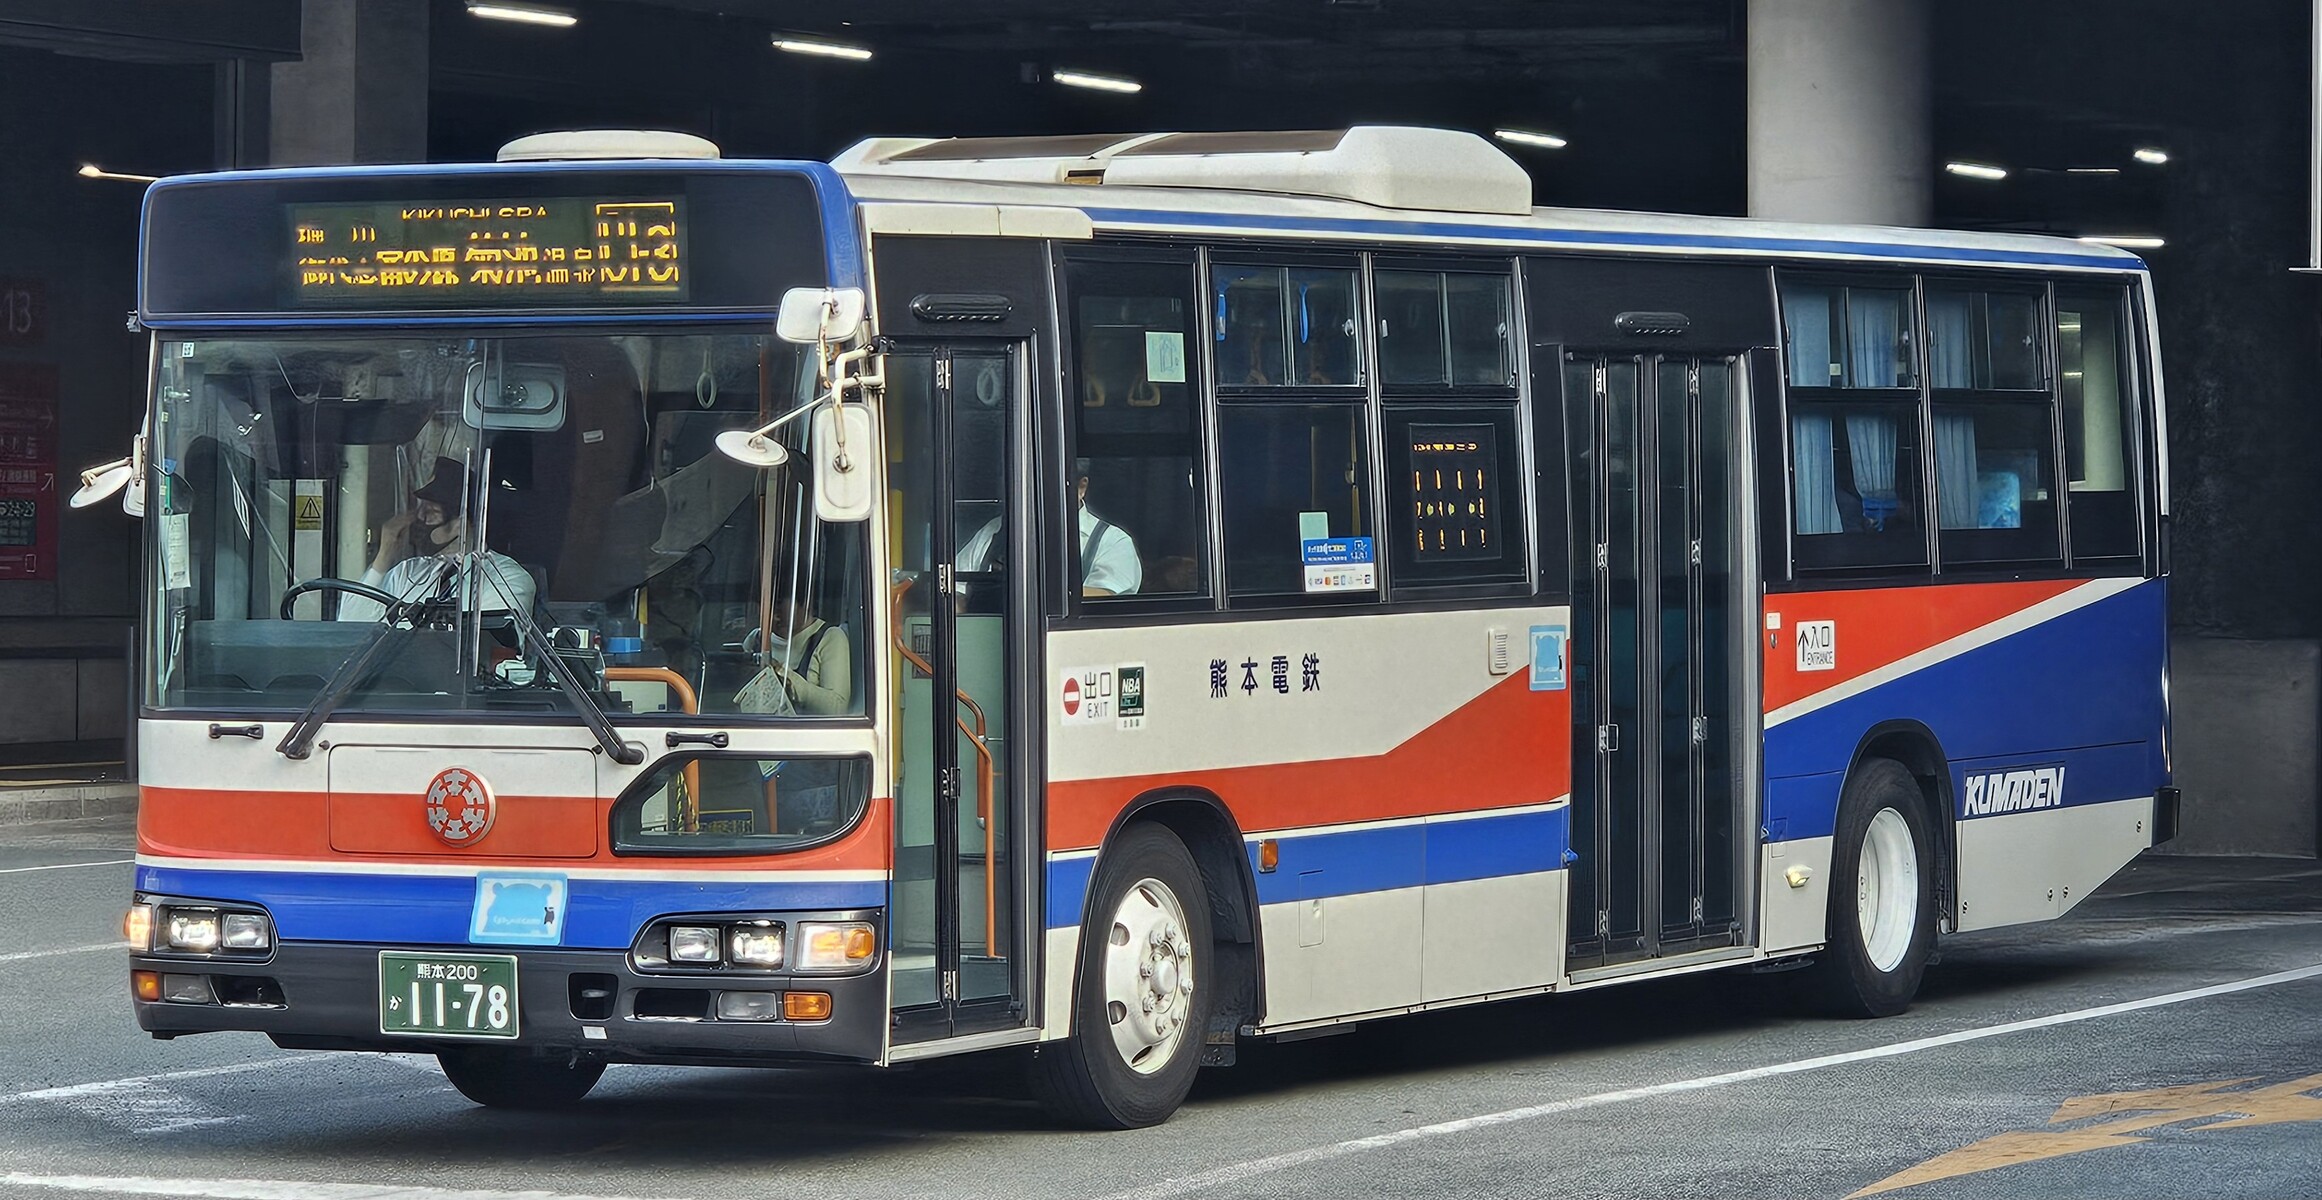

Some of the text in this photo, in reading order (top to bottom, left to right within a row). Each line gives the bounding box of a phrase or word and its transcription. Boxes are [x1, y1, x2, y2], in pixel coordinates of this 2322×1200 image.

[1810, 625, 1830, 650] 入口
[1084, 671, 1112, 700] 出口
[1121, 677, 1141, 694] NBA
[1209, 652, 1321, 699] 熊本電鉄
[1087, 701, 1108, 719] EXIT
[1963, 766, 2066, 817] KUMADEN
